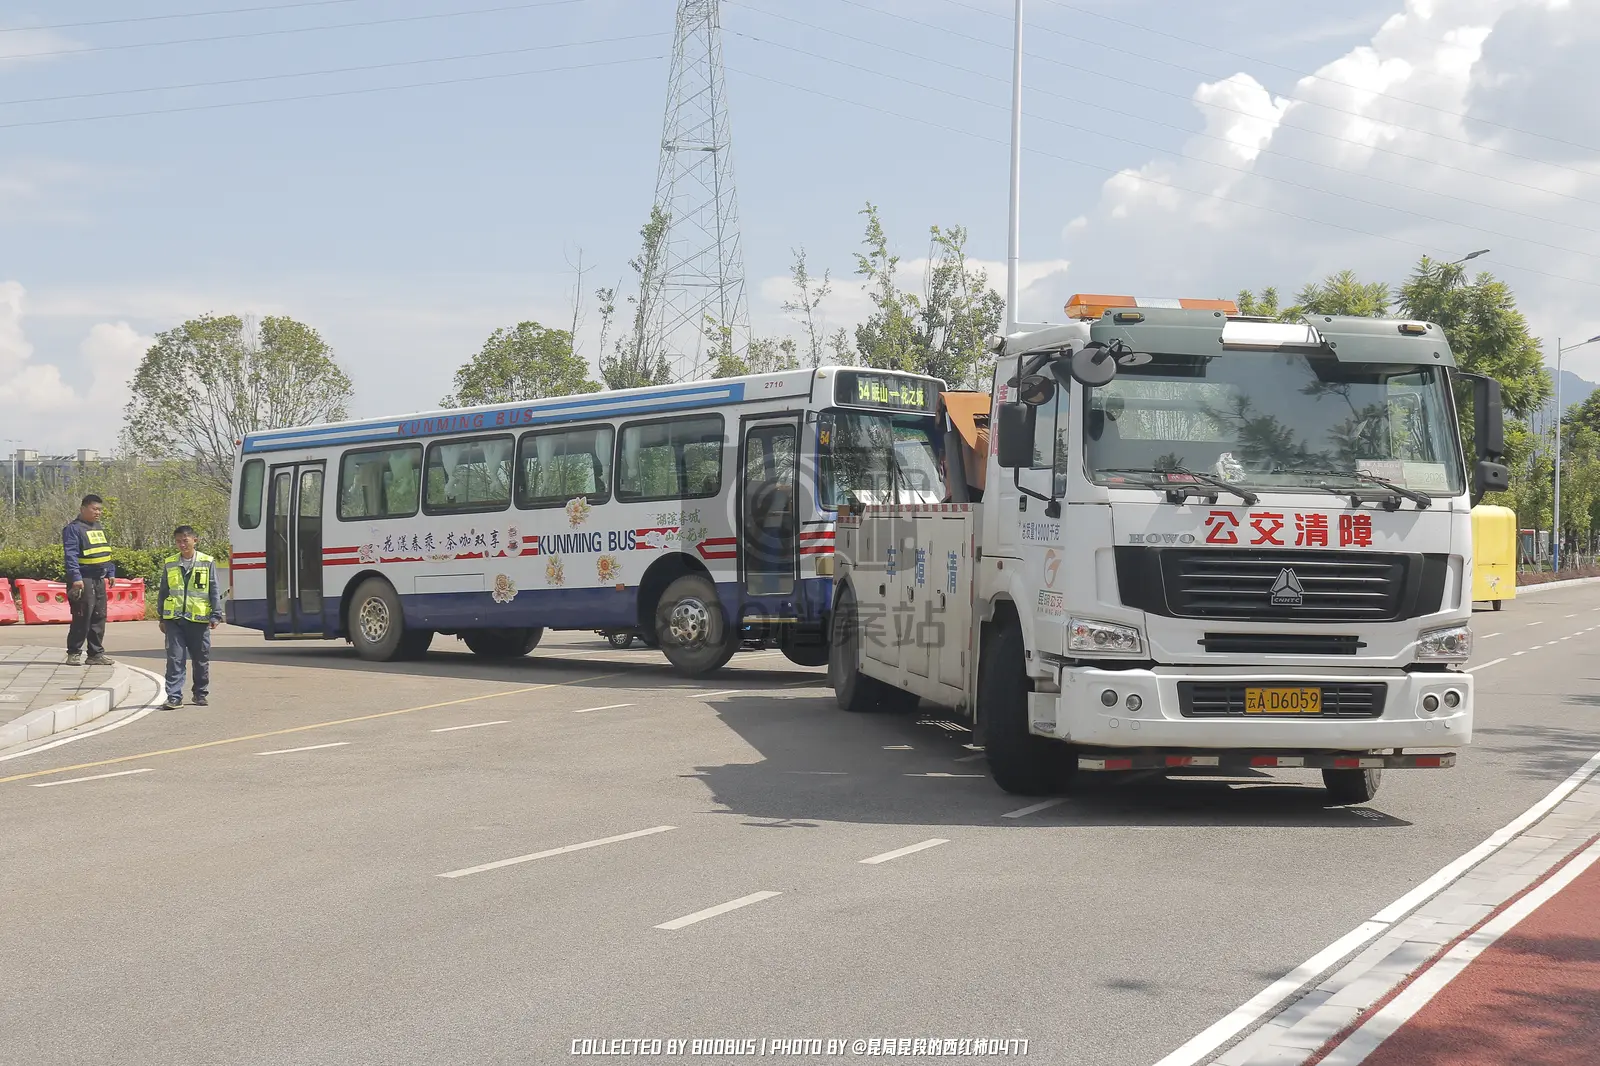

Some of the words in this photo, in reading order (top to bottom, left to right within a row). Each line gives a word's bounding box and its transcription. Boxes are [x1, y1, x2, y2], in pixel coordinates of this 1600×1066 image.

[764, 381, 784, 389] 2710
[858, 380, 870, 400] 54
[397, 414, 484, 436] KUNMING
[496, 409, 534, 425] BUS
[820, 430, 830, 445] 54
[1204, 510, 1373, 548] 公交清障
[537, 532, 602, 556] KUNMING
[608, 529, 637, 552] BUS
[1128, 533, 1196, 544] HOWO
[1038, 592, 1063, 609] 昆明公交
